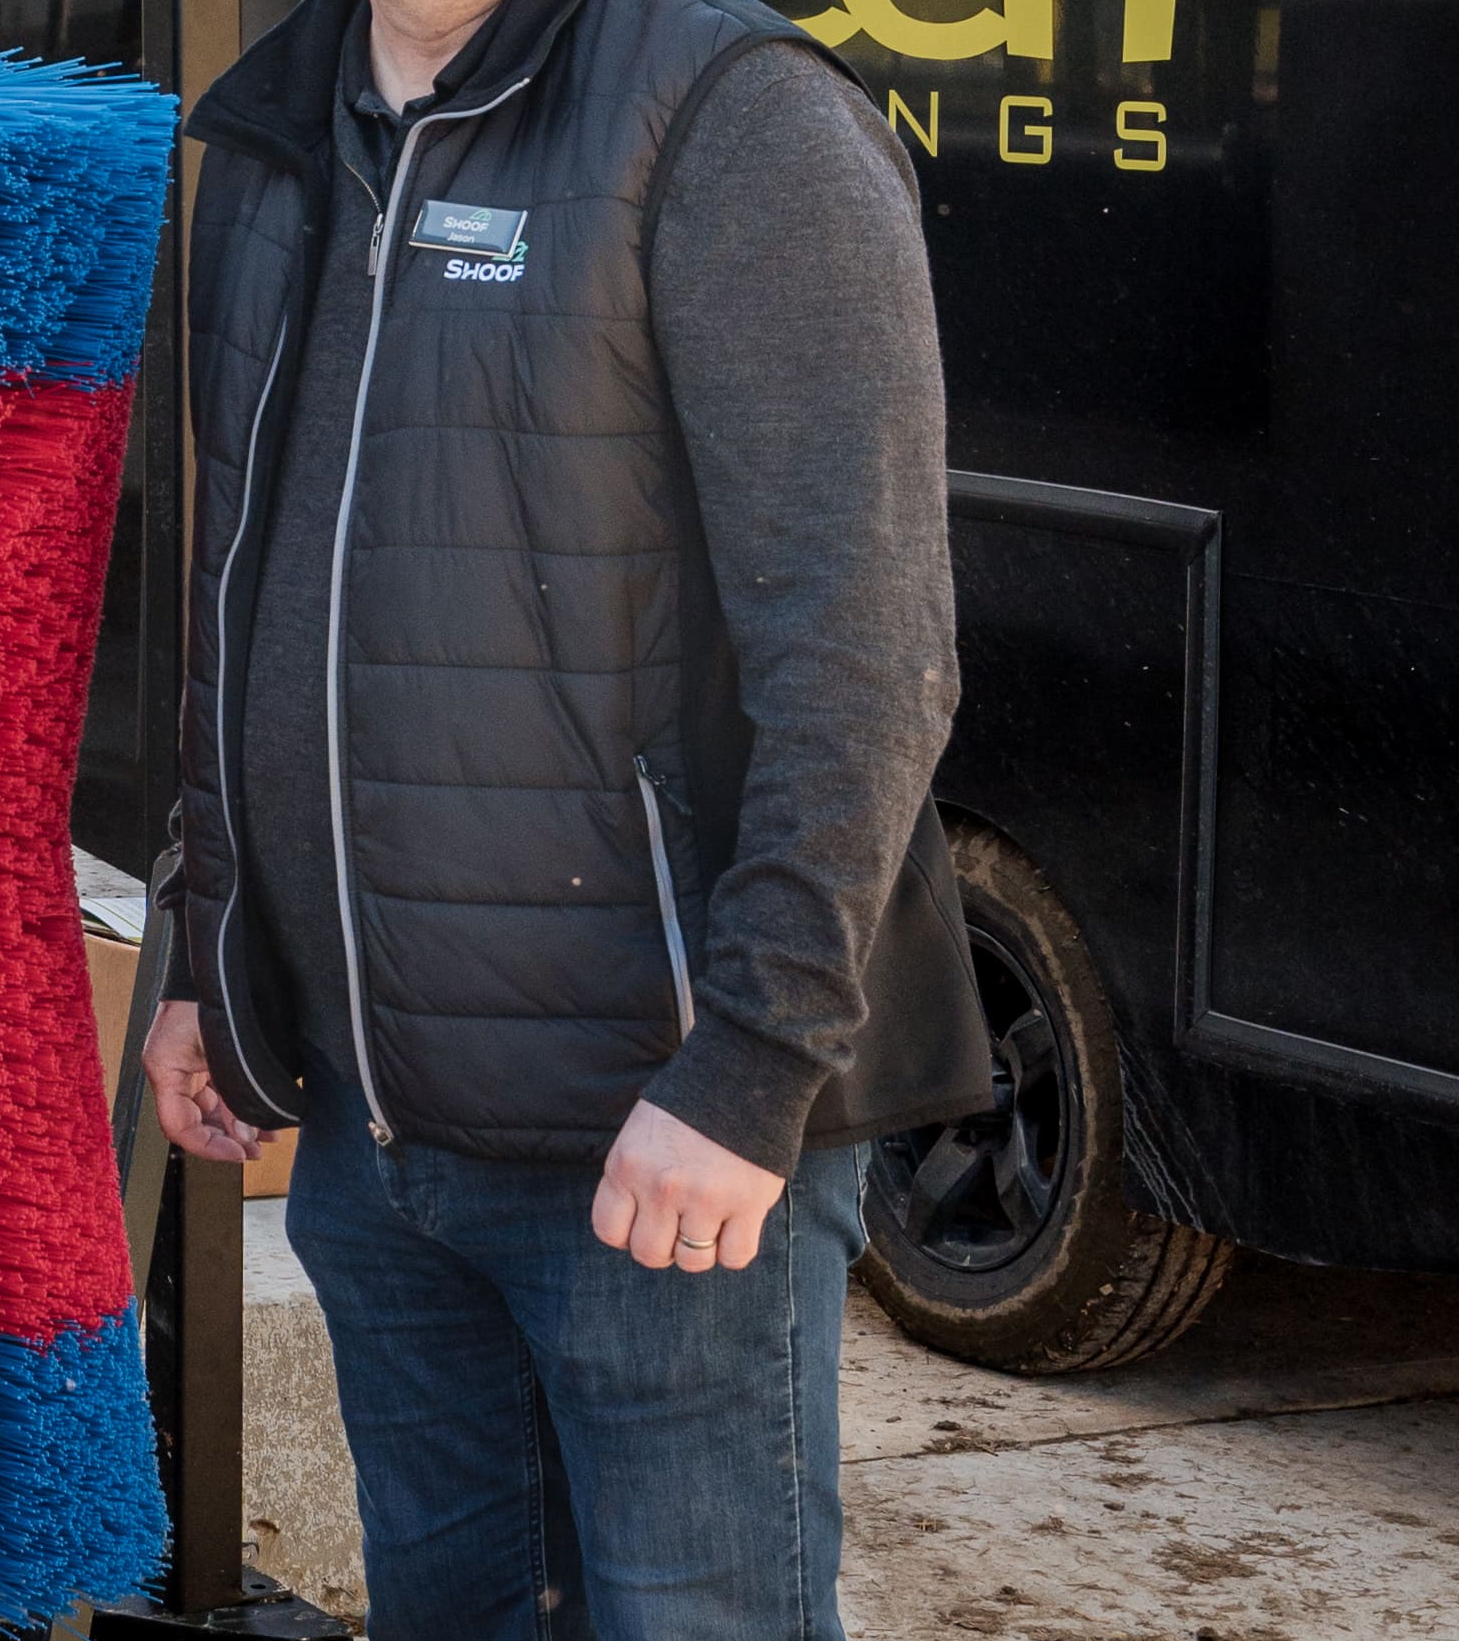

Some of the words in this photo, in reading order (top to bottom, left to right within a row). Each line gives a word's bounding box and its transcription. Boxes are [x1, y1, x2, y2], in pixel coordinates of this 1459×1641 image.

[443, 216, 489, 232] SHOOF
[447, 231, 475, 244] Jason
[444, 259, 525, 282] SHOOF
